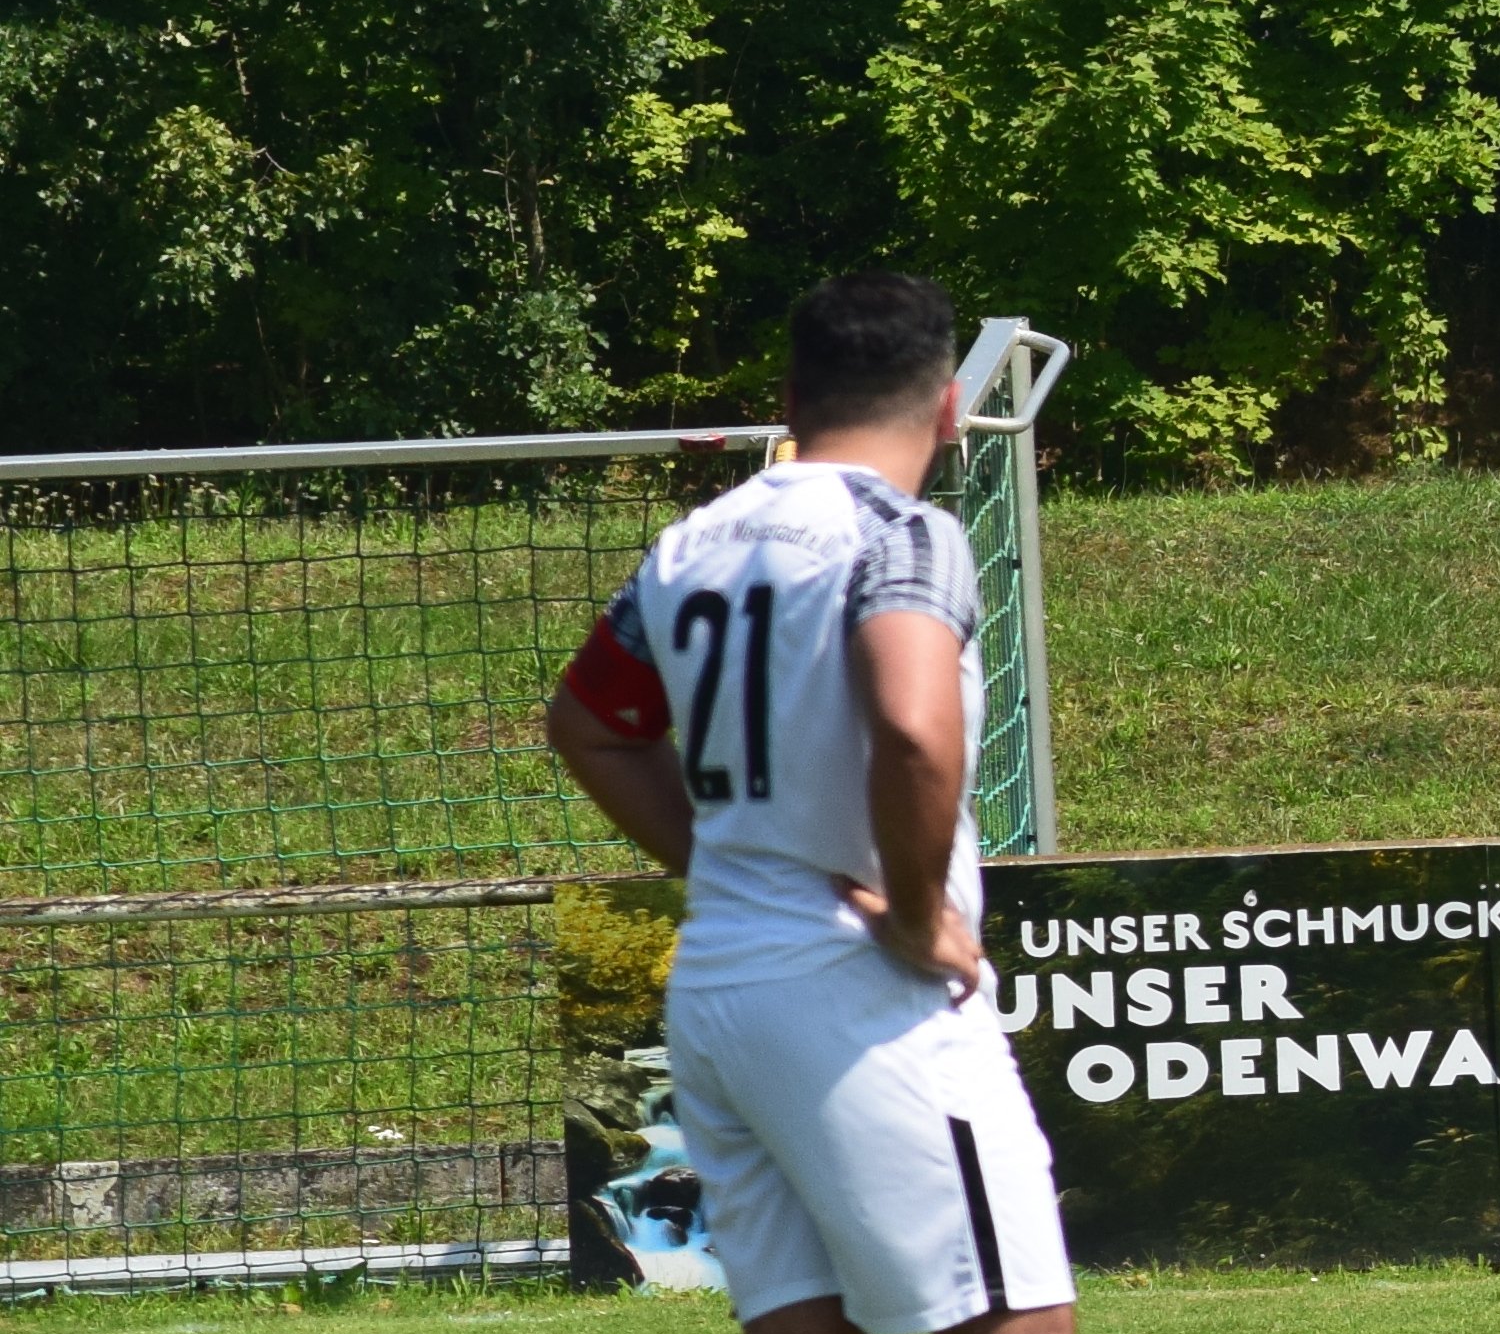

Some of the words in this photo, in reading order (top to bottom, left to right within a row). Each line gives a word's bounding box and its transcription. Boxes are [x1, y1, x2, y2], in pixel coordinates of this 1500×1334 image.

[674, 581, 774, 802] 21
[1021, 914, 1211, 958] UNSER
[996, 964, 1304, 1033] UNSER
